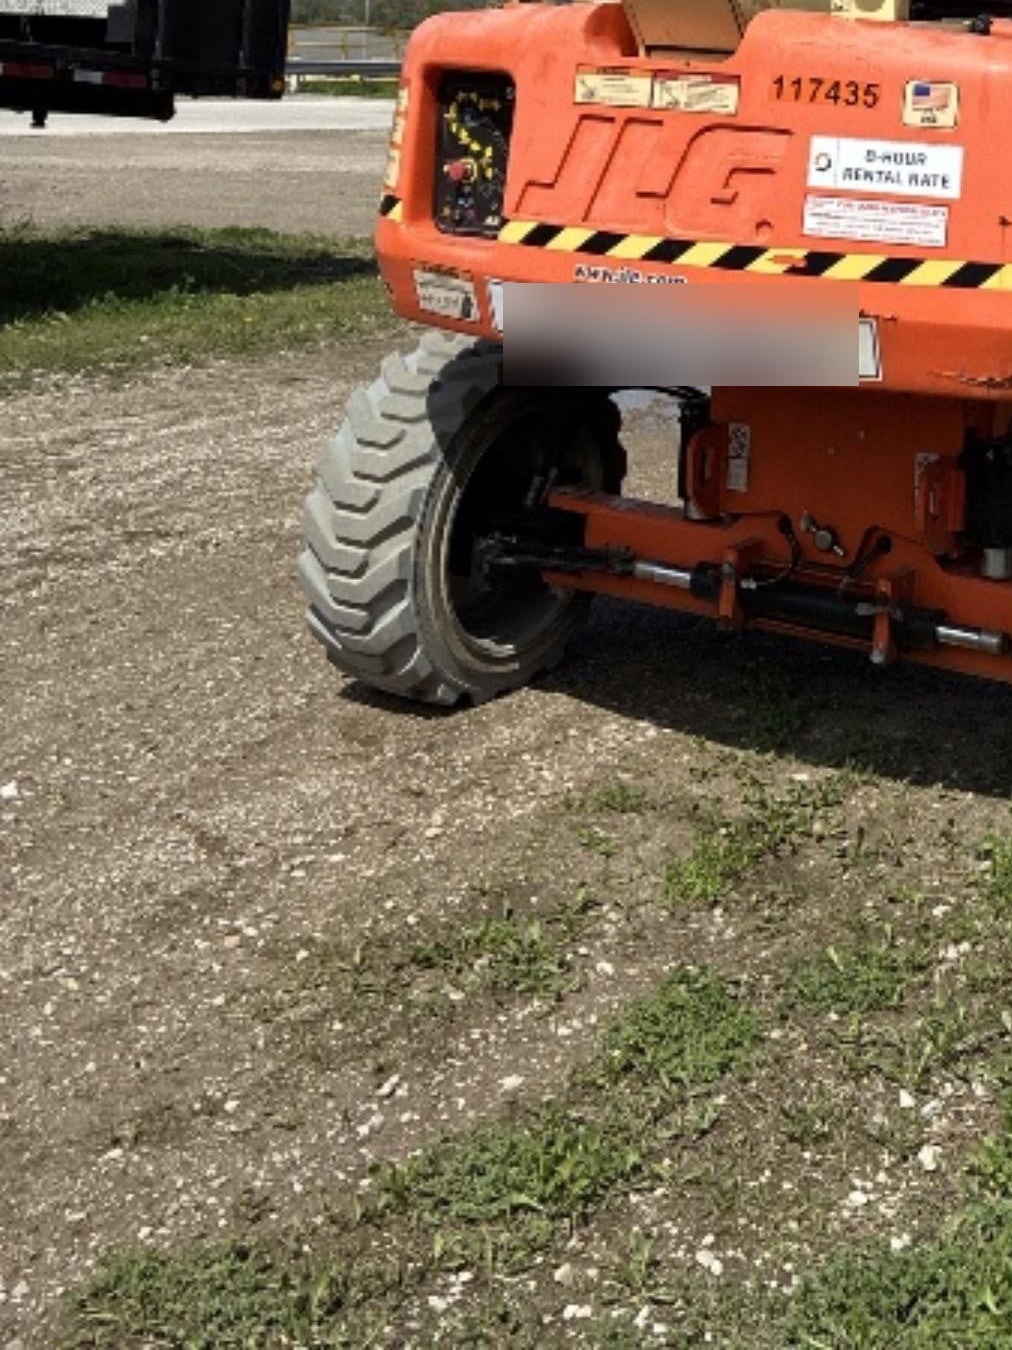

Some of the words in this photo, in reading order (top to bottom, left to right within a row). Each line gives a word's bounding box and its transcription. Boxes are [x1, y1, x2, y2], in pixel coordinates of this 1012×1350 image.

[773, 75, 880, 109] 117435
[507, 114, 794, 238] JLG
[842, 167, 902, 184] RENTAL
[908, 173, 951, 189] RATE
